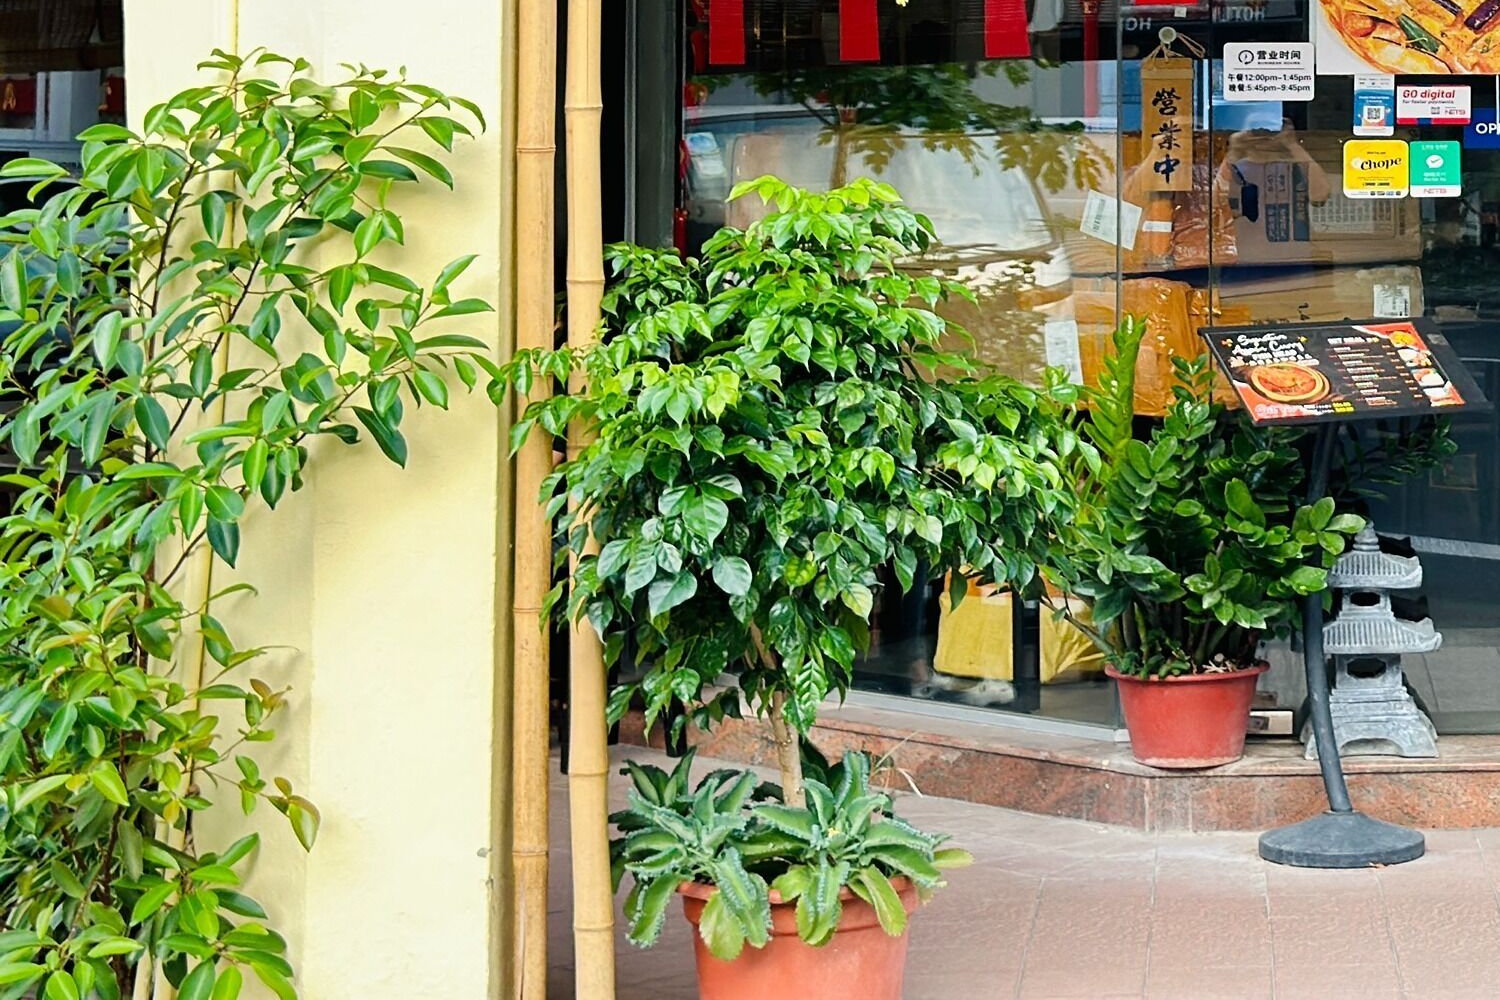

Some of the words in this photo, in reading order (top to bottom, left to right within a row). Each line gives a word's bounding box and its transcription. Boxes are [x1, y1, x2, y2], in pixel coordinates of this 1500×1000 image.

[1257, 50, 1301, 60] 营业时间
[1402, 90, 1418, 99] GO
[1420, 89, 1456, 100] digital
[1151, 87, 1181, 185] 營業中
